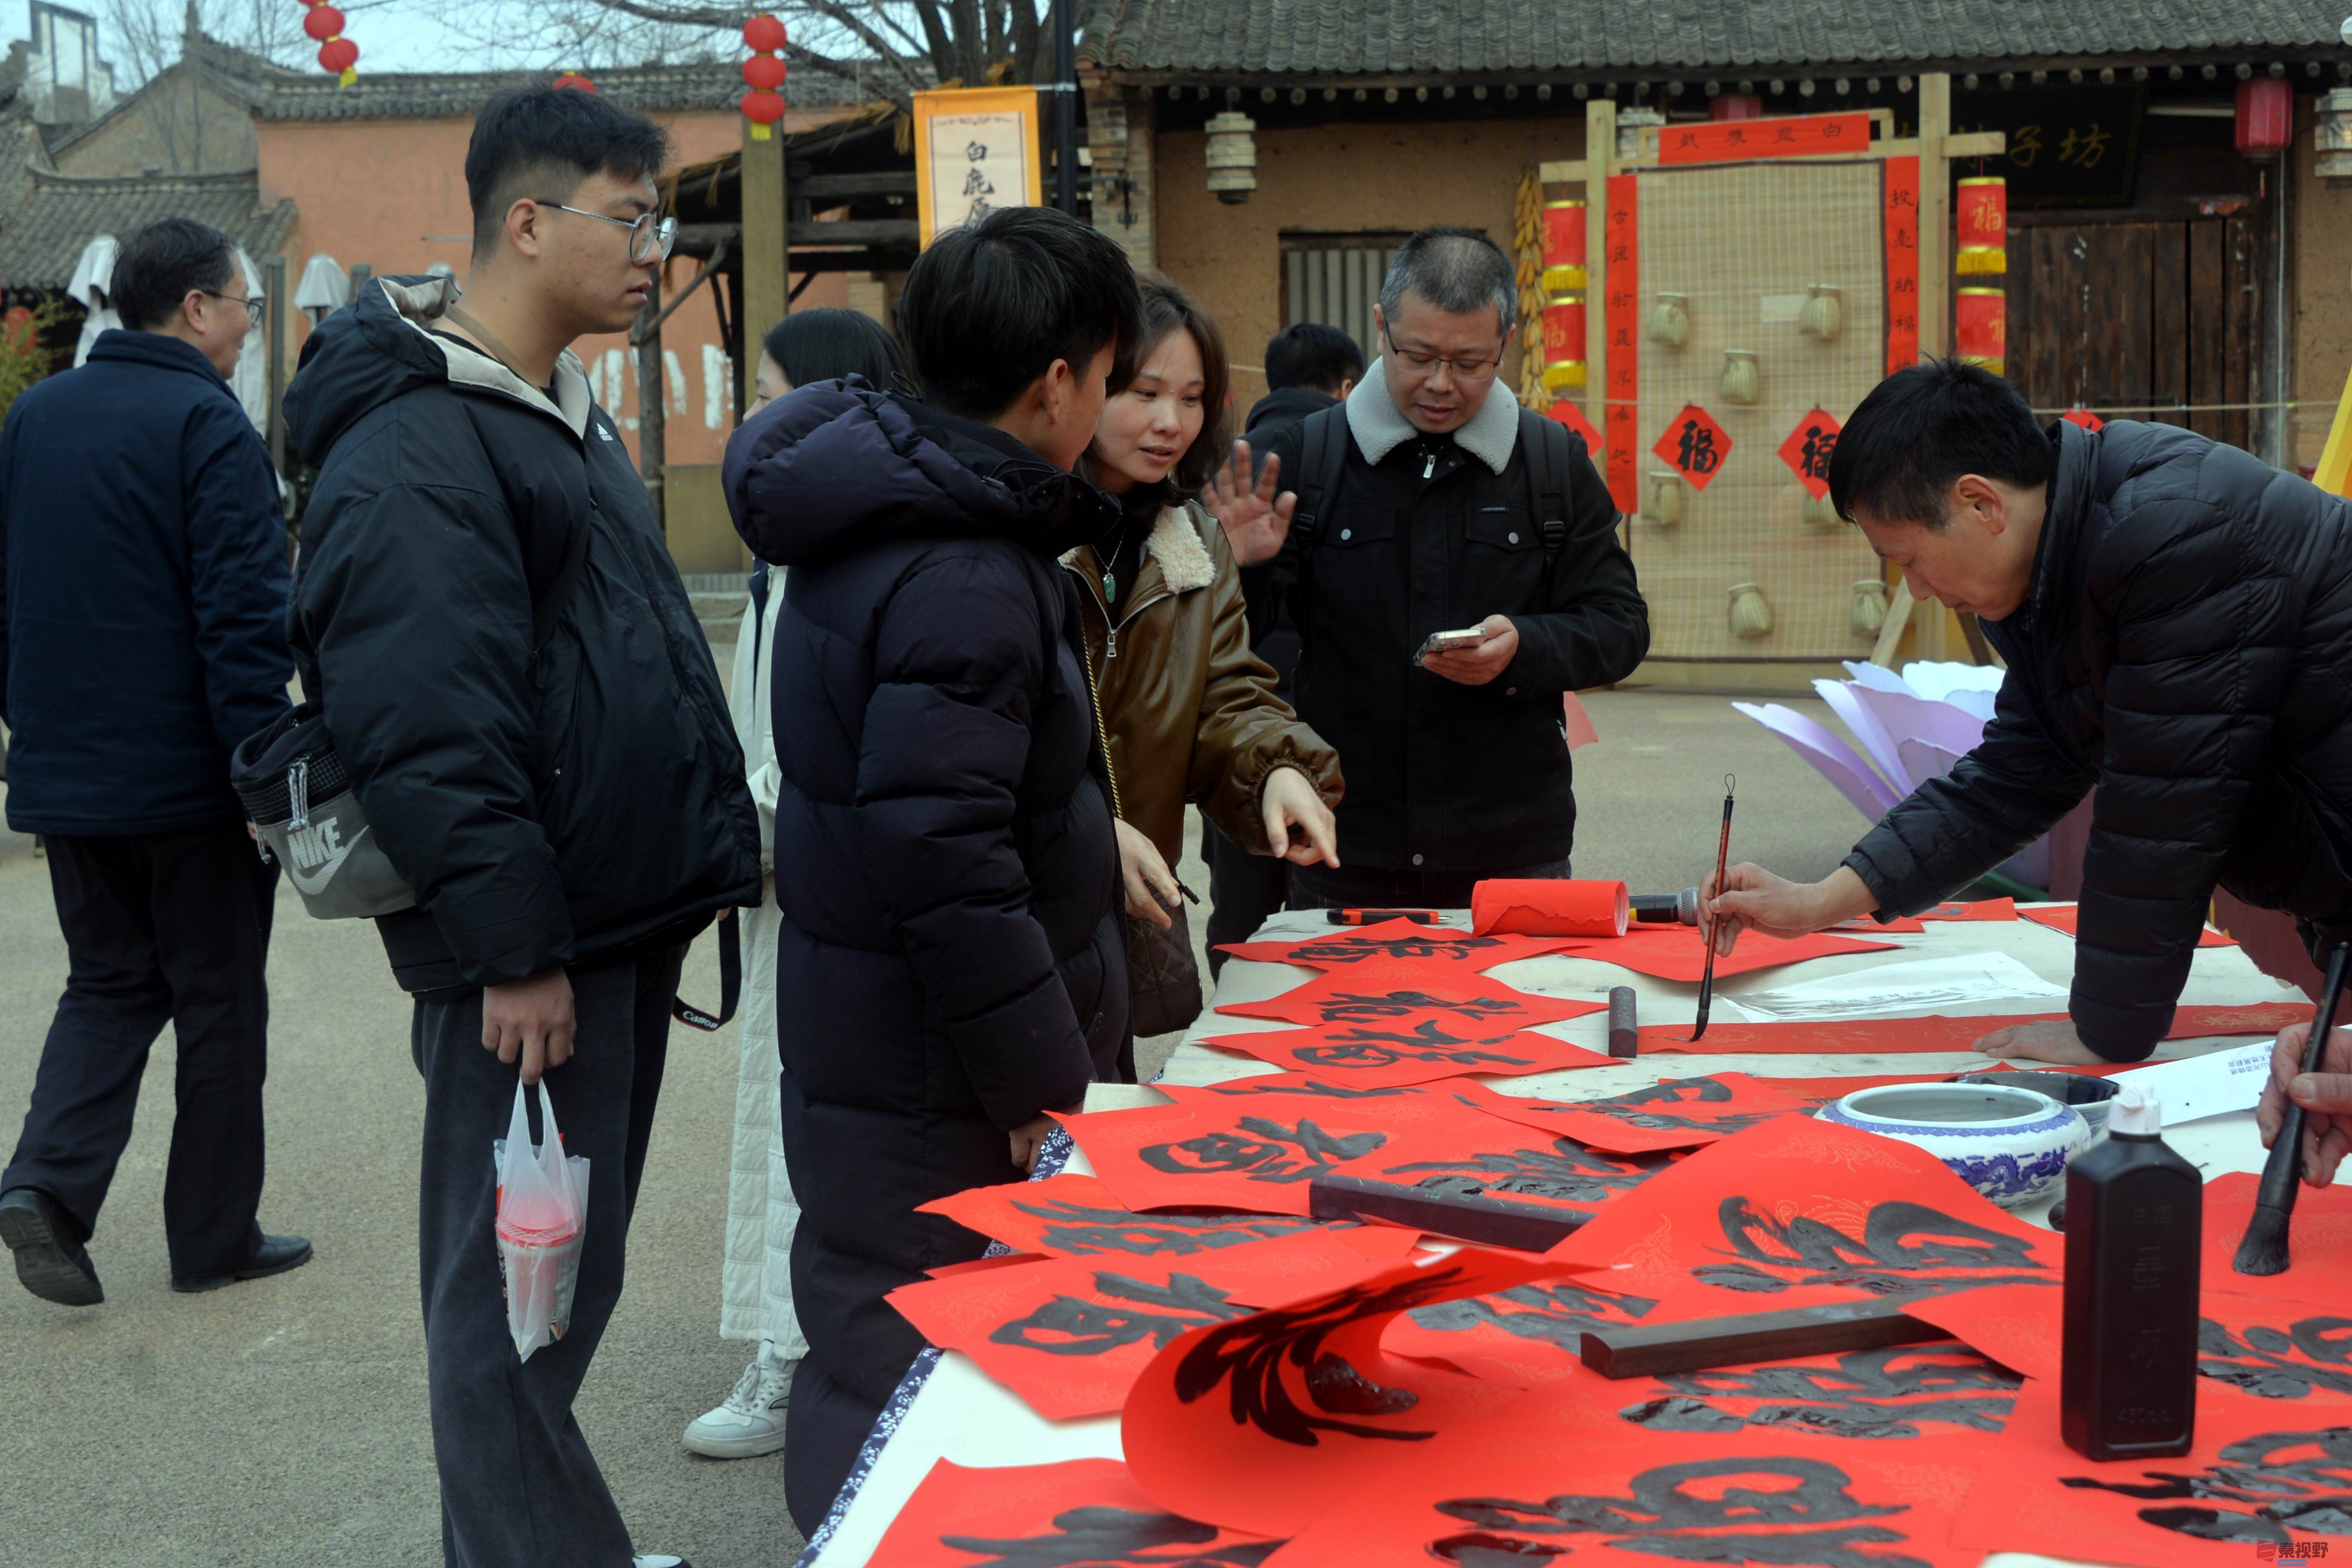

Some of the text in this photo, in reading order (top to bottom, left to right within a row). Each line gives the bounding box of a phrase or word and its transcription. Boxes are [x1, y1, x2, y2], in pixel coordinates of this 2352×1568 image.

[1970, 197, 2002, 232] 福
[1677, 420, 1718, 474] 福
[1800, 425, 1839, 483] 福
[287, 817, 345, 869] NIKE
[682, 1010, 718, 1028] Canon
